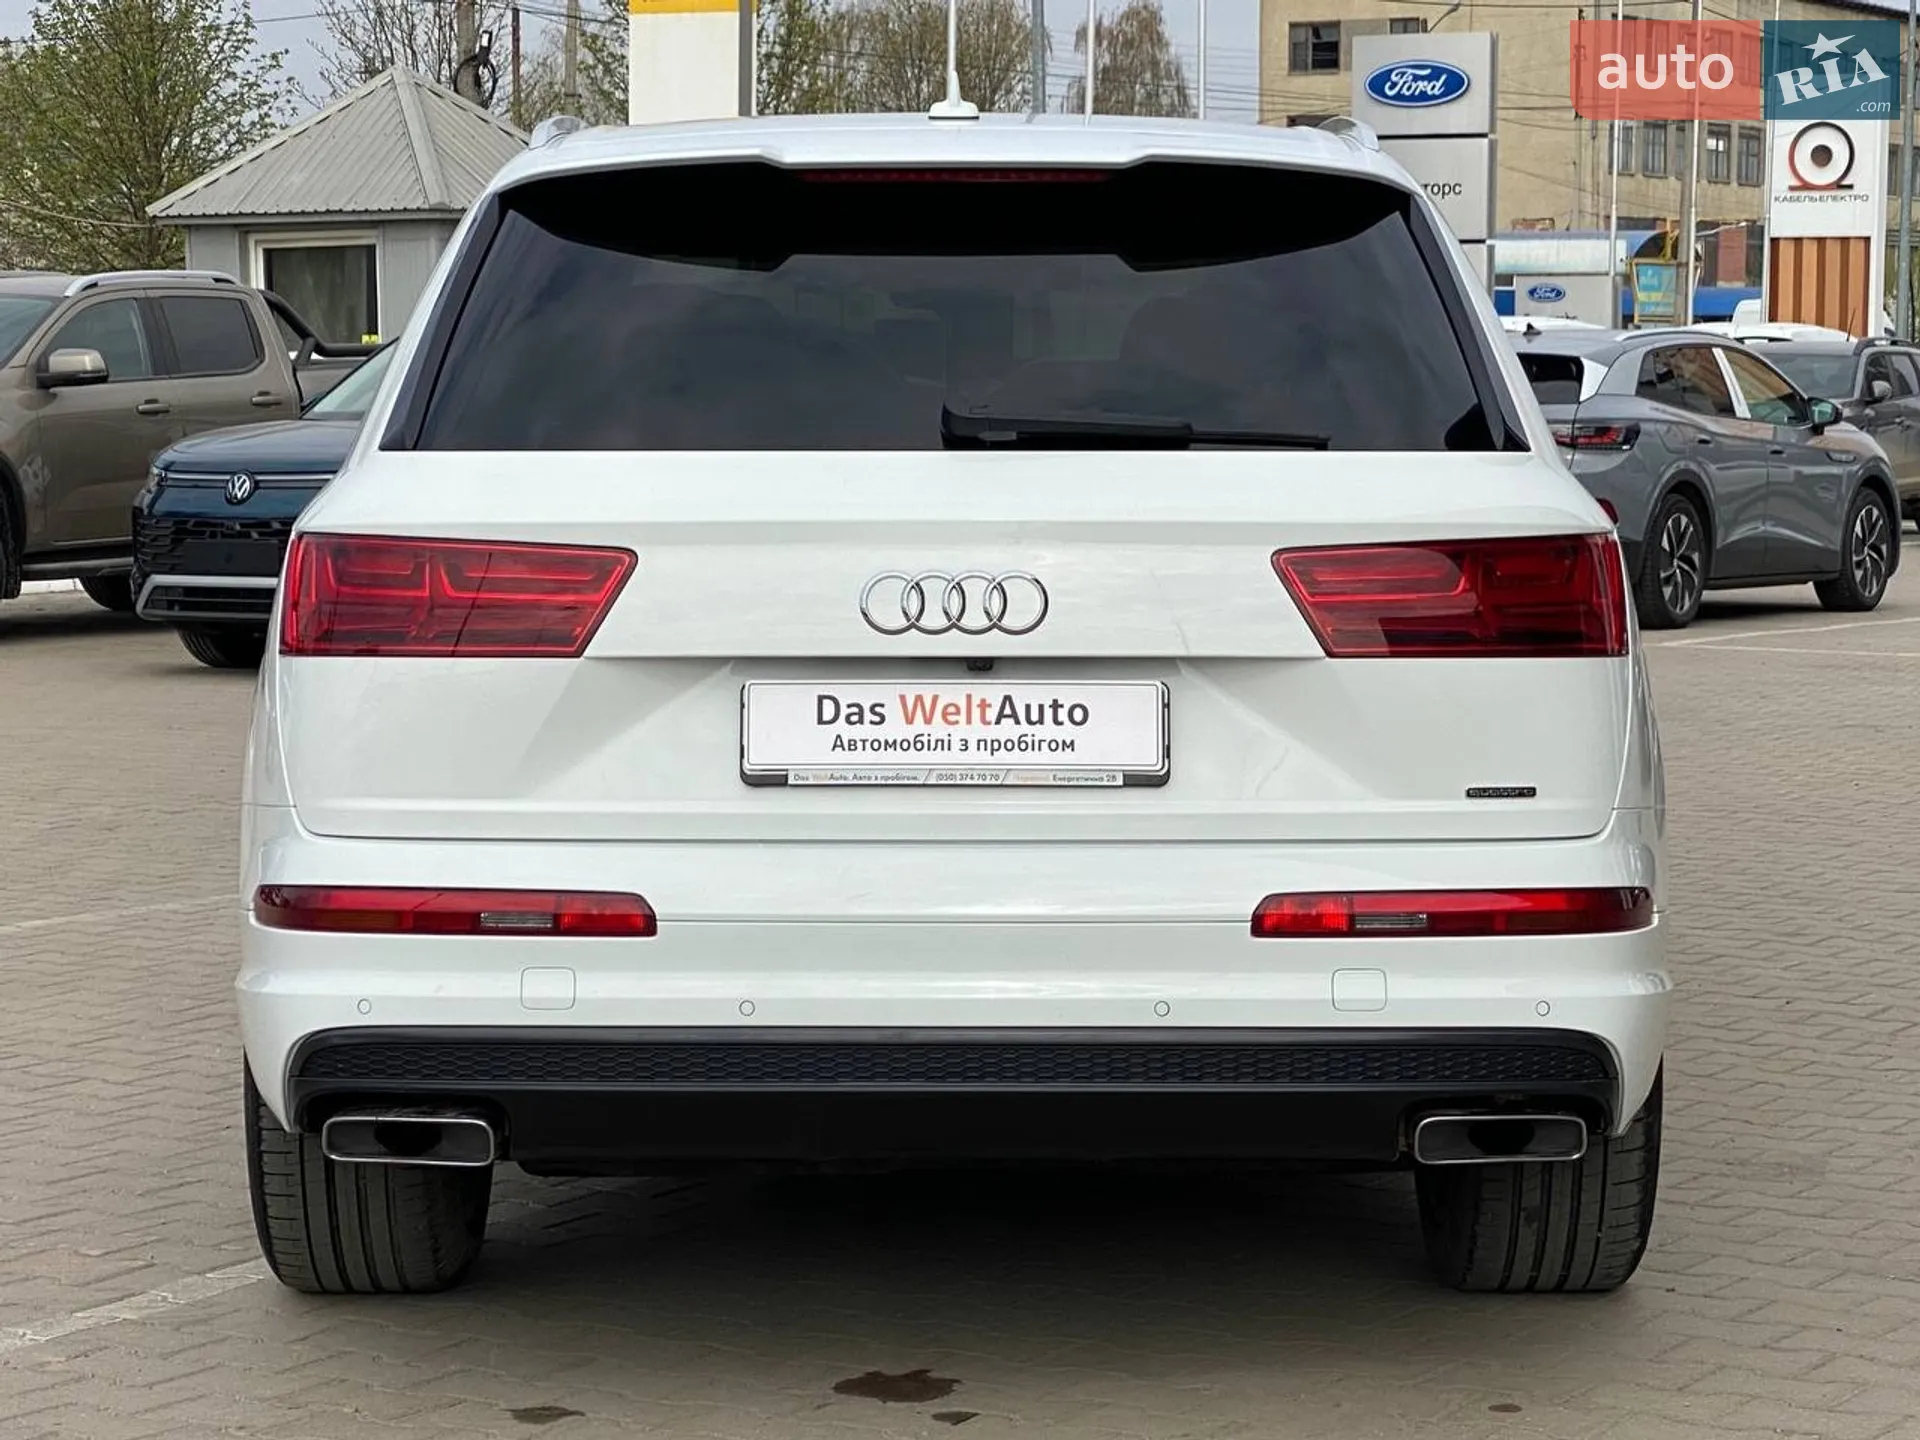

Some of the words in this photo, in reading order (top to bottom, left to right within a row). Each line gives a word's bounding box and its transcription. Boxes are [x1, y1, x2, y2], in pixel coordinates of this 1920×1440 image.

[1384, 68, 1448, 97] Ford
[816, 694, 887, 727] Das
[899, 693, 1090, 727] WeltAuto
[831, 733, 951, 753] Автомобілі
[959, 738, 969, 753] з
[976, 733, 1076, 757] пробігом
[958, 773, 975, 782] 374
[976, 773, 987, 782] 70
[989, 773, 1000, 782] 70
